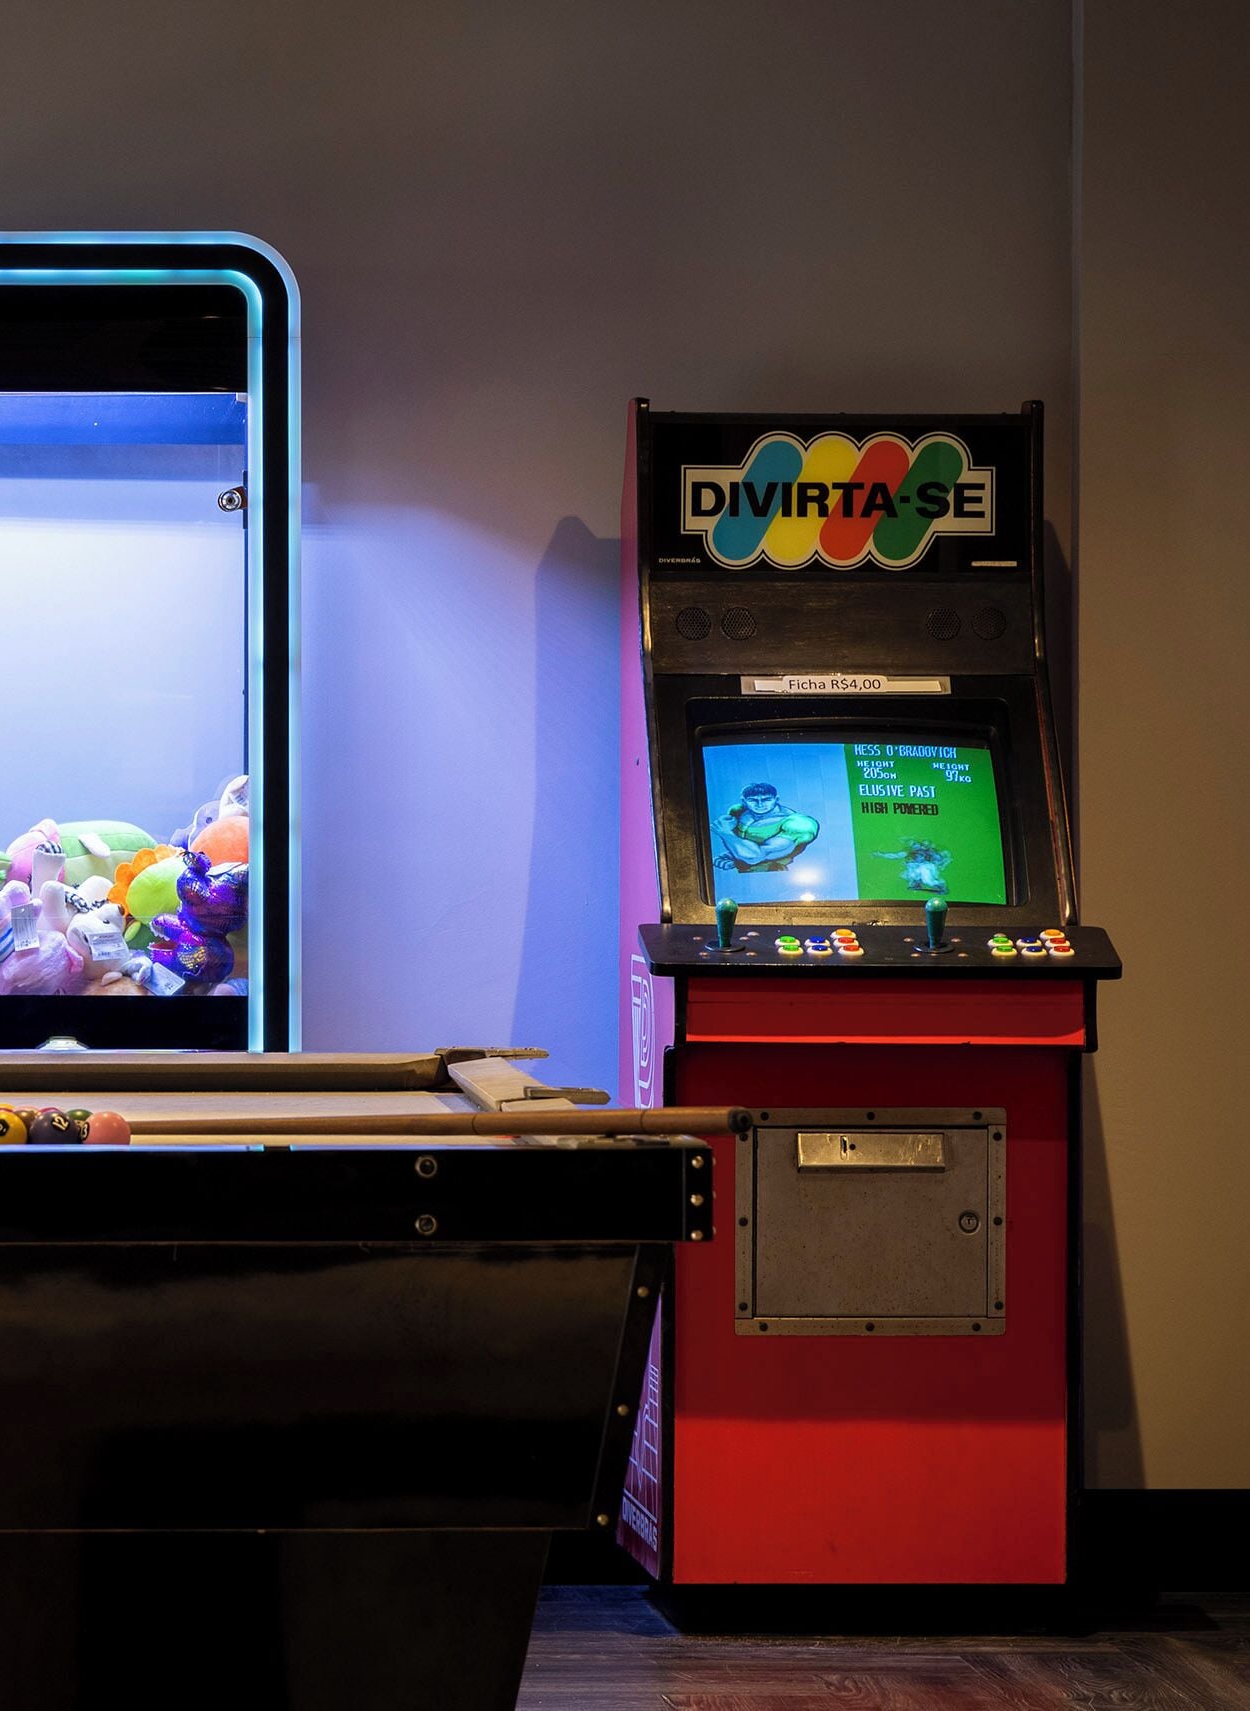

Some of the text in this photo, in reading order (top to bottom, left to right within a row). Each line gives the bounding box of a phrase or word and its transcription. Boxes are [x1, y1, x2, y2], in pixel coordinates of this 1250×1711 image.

[690, 481, 986, 518] DIVIRTA-SE
[788, 678, 881, 691] Ficha R$4,00
[856, 760, 895, 768] HEIGHT
[859, 784, 936, 798] ELUSIVE PAST
[861, 802, 939, 816] HIGH POWERED
[52, 1115, 69, 1131] 12
